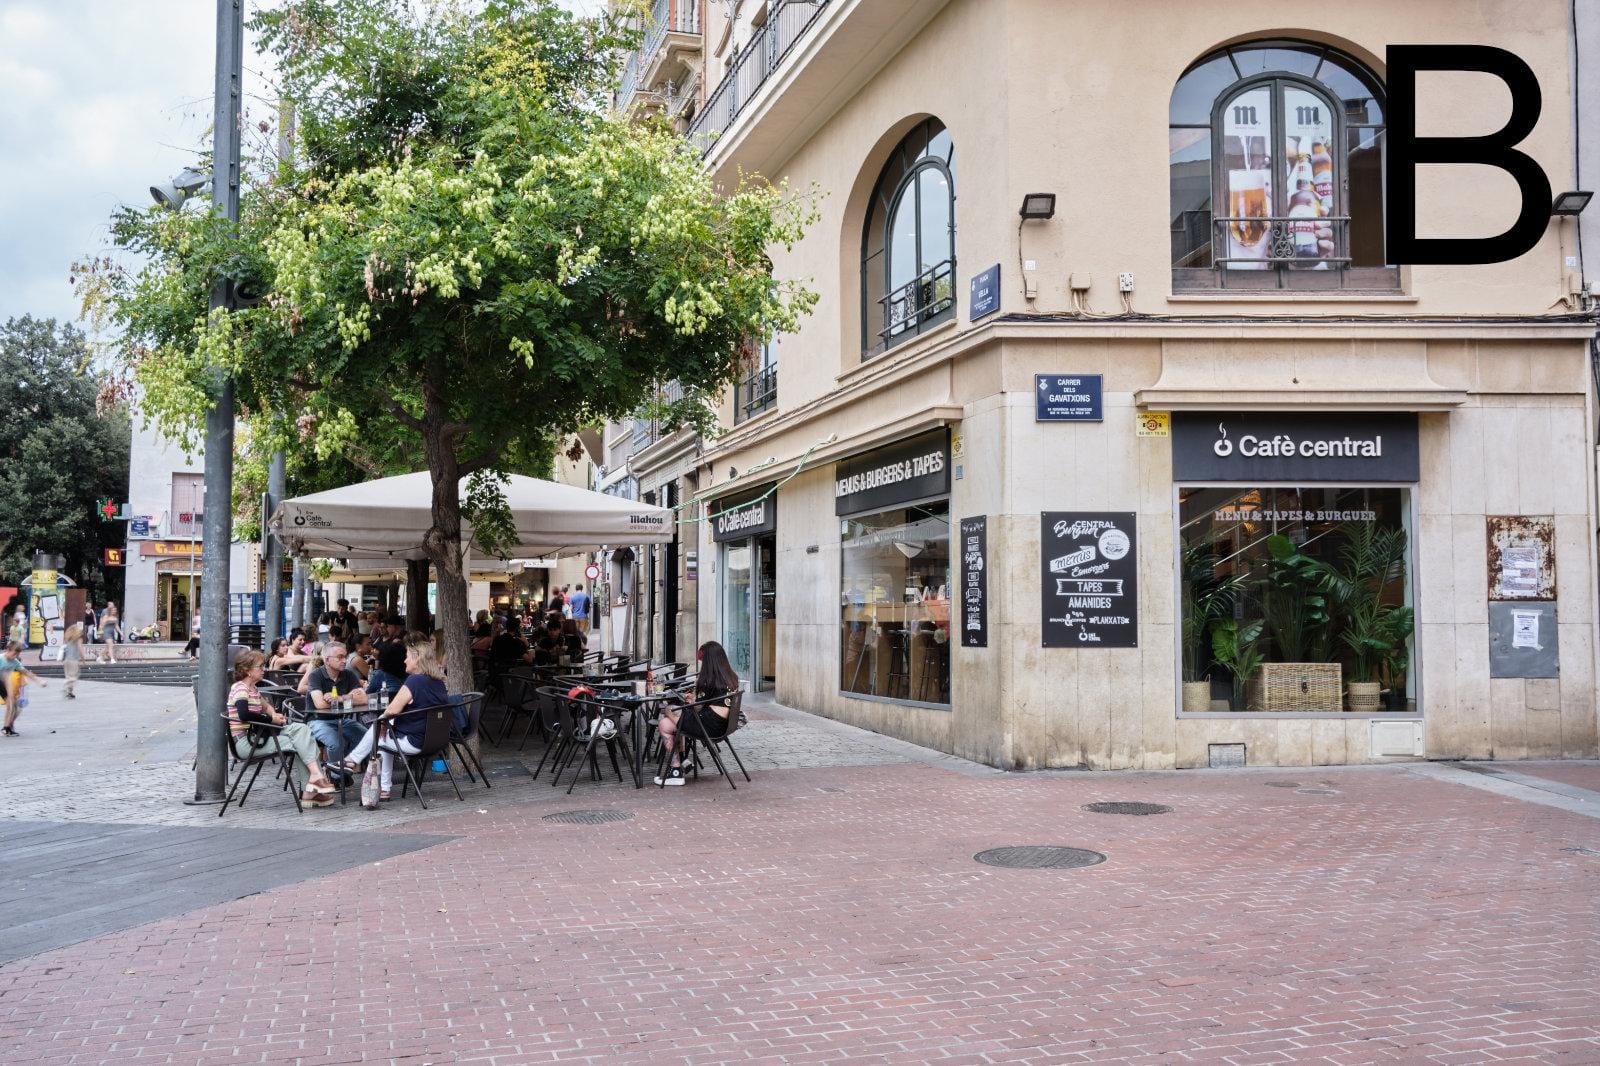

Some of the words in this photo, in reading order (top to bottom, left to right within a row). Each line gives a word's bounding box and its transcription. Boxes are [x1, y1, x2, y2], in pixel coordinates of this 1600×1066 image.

[1057, 378, 1081, 386] CARRER
[1049, 394, 1091, 403] GAVATXONS
[1239, 435, 1296, 457] Cafè
[1299, 435, 1382, 457] central
[860, 472, 867, 491] &
[866, 462, 905, 490] BURGERS
[904, 460, 913, 480] &
[912, 451, 944, 477] TAPES
[630, 515, 663, 524] Mahou
[740, 501, 766, 529] central
[1251, 511, 1262, 521] &
[1263, 510, 1304, 521] TAPES
[1304, 511, 1315, 521] &
[1316, 510, 1377, 521] BURGUER
[1075, 520, 1116, 529] CENTRAL
[173, 543, 202, 552] TABA
[1077, 582, 1103, 593] TAPES
[1068, 597, 1112, 609] AMANIDES
